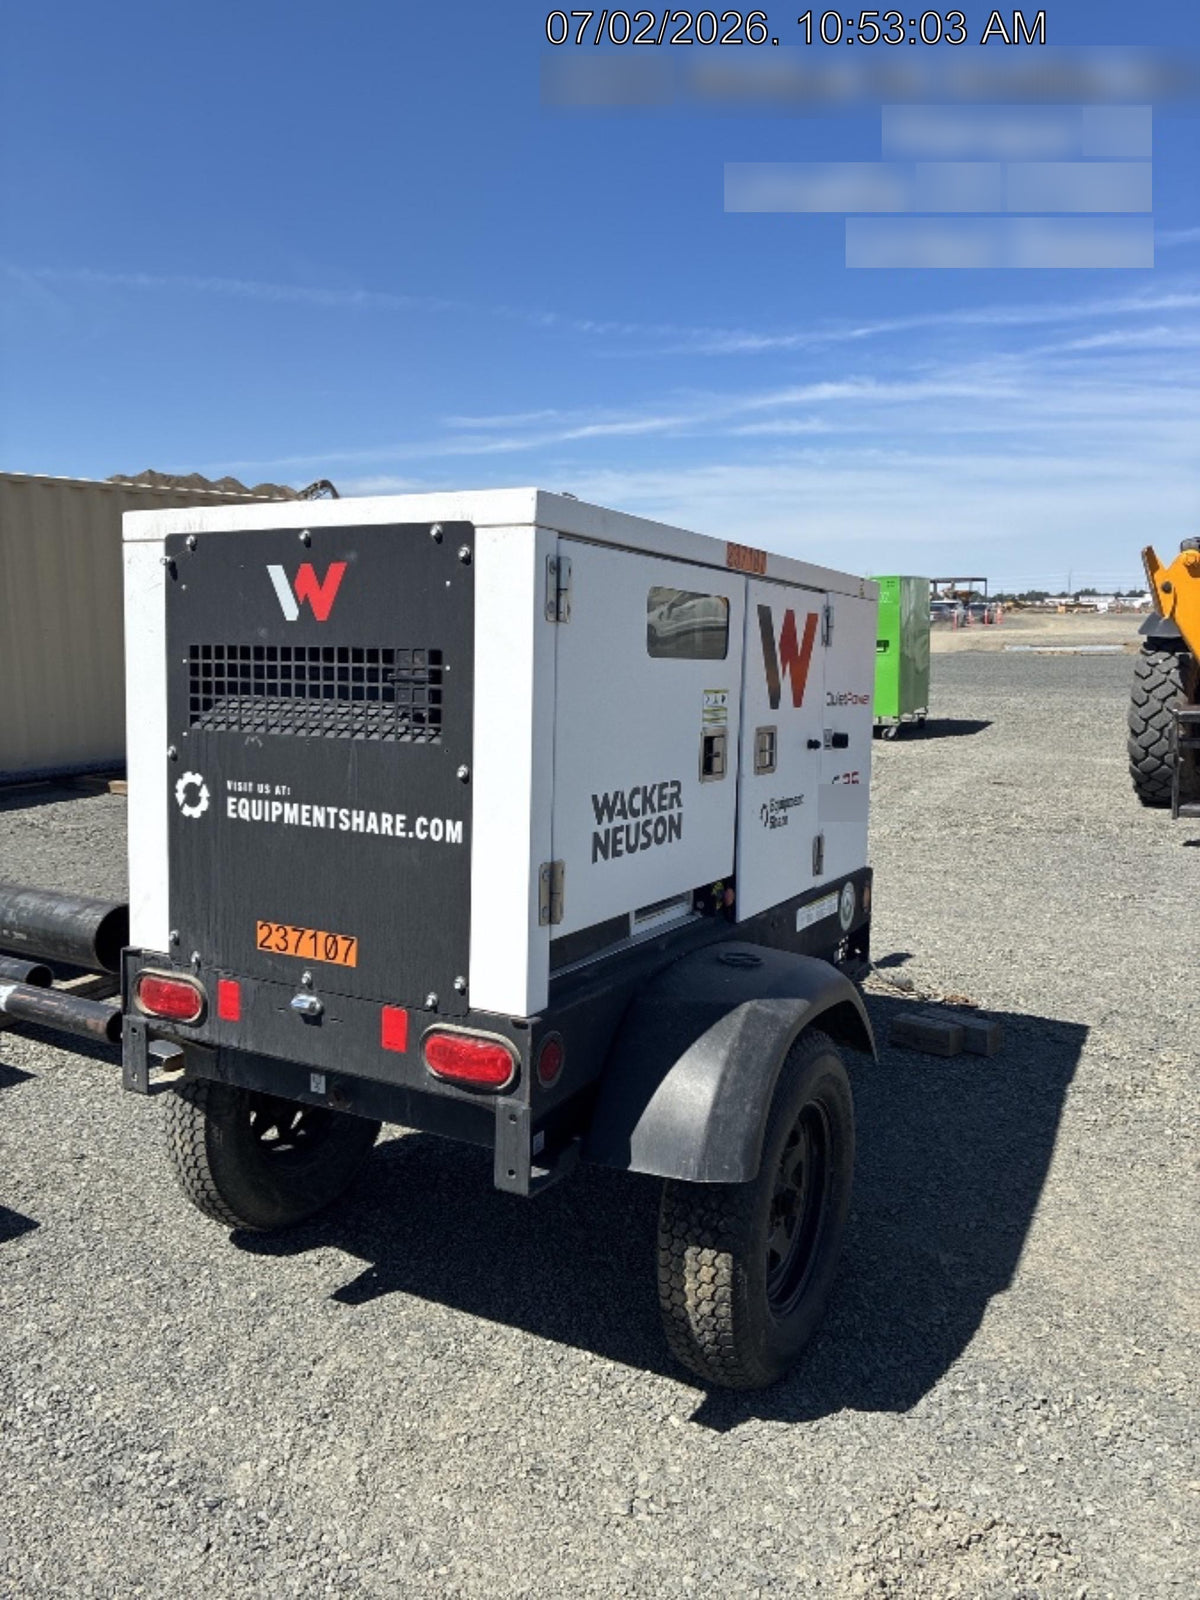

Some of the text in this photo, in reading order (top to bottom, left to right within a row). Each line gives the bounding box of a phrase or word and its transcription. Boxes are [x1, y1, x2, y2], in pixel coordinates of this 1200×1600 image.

[226, 780, 291, 796] VISIT US AT:
[591, 780, 683, 826] WACKER
[226, 796, 463, 844] EQUIPMENTSHARE.COM
[591, 812, 683, 864] NEUSON
[258, 923, 356, 964] 237107
